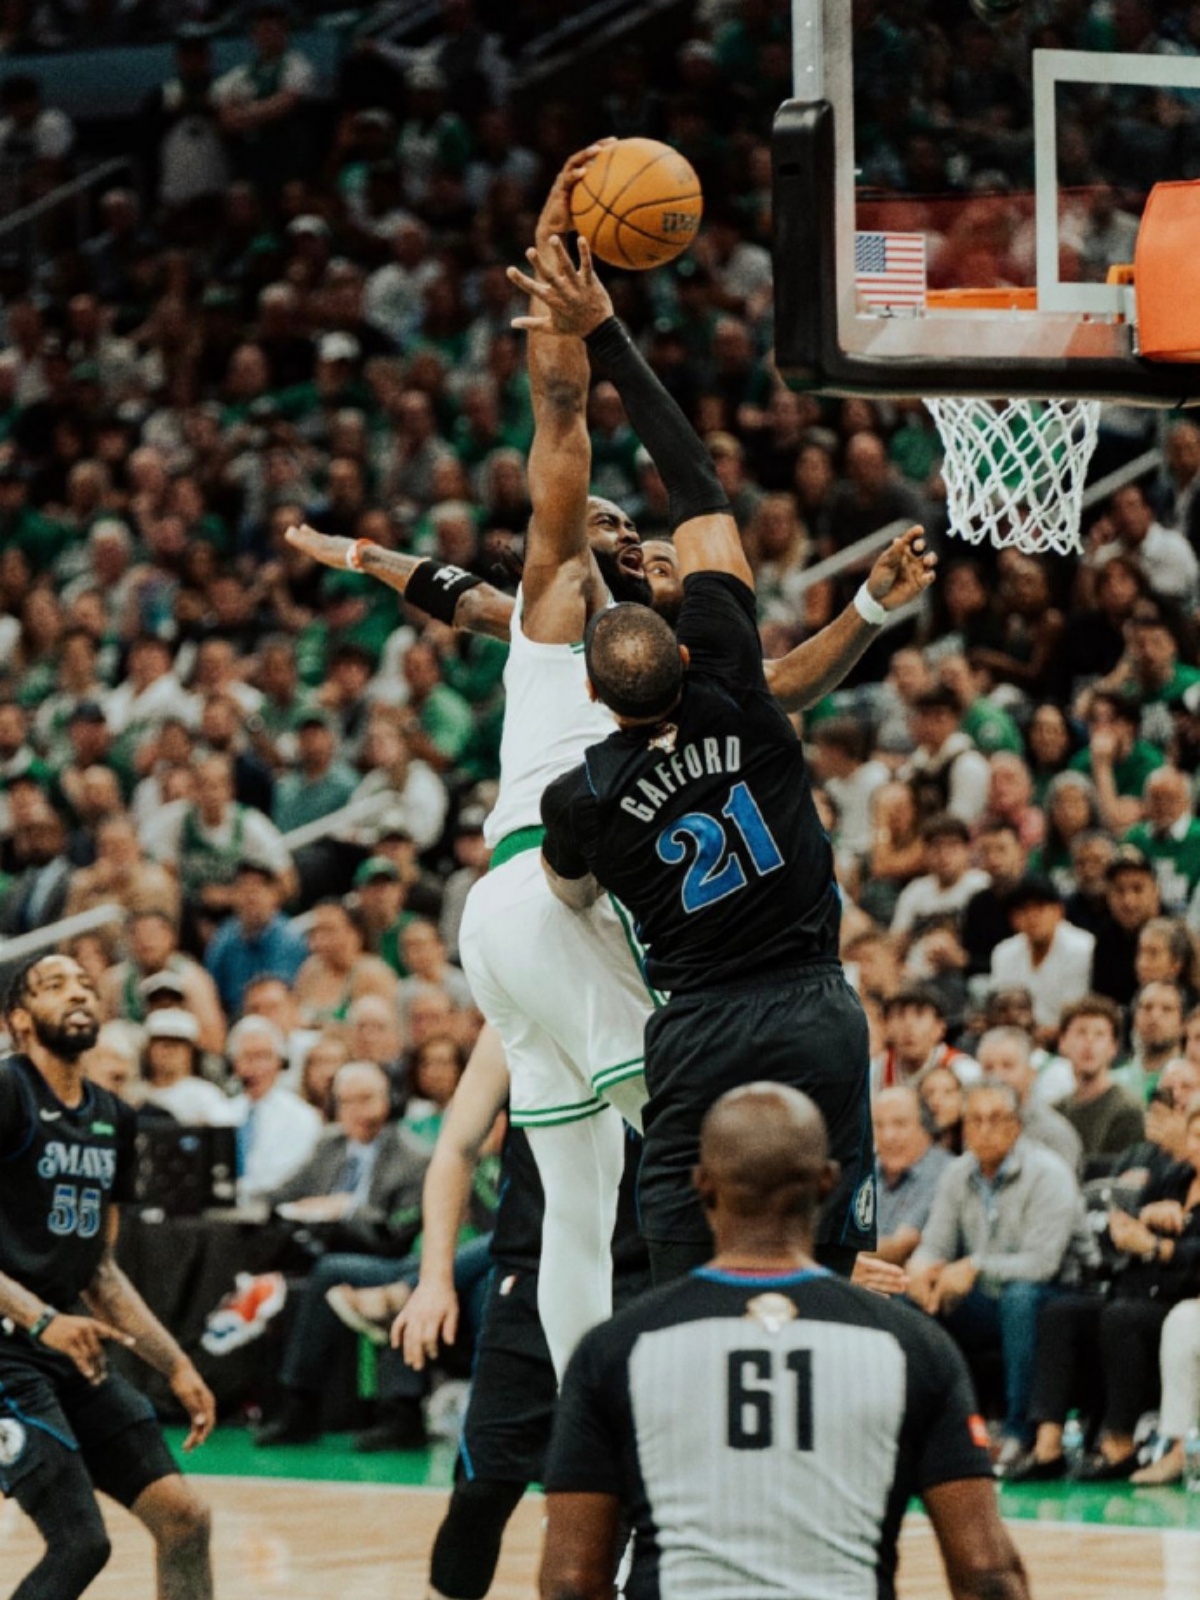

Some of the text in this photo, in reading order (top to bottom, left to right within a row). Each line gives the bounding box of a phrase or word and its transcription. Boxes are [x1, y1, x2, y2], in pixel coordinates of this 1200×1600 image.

[620, 735, 741, 823] GAFFORD
[655, 780, 785, 914] 21
[47, 1184, 101, 1238] 55
[728, 1349, 814, 1451] 61
